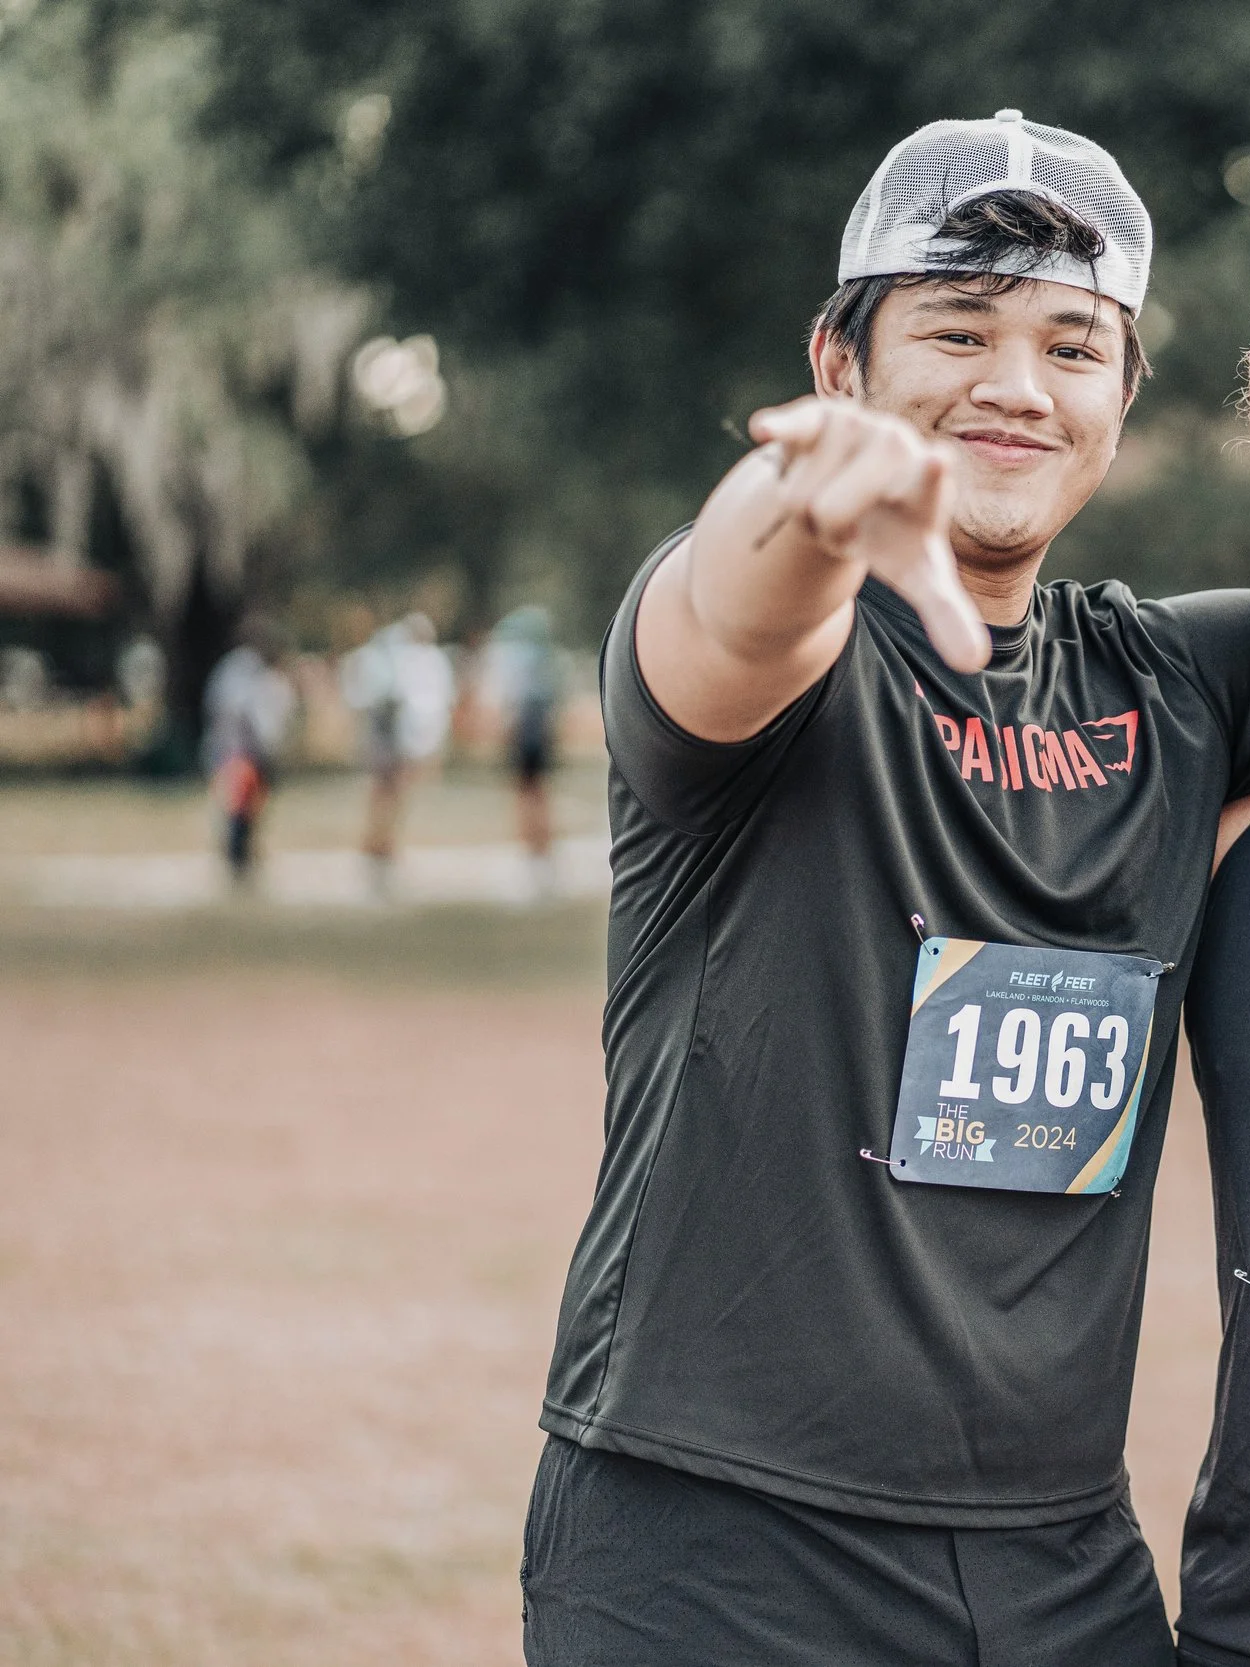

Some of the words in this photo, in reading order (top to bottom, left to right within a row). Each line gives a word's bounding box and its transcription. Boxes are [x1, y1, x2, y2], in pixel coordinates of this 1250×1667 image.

[1009, 971, 1050, 987] FLEET
[1064, 976, 1096, 991] FEET
[985, 990, 1026, 1002] LAKELAND
[1031, 994, 1065, 1004] BRANDON
[1070, 997, 1110, 1008] FLATWOODS
[939, 1004, 1129, 1110] 1963
[936, 1103, 970, 1119] THE
[935, 1118, 985, 1145] BIG
[1014, 1123, 1077, 1150] 2024
[932, 1141, 975, 1161] RUN
